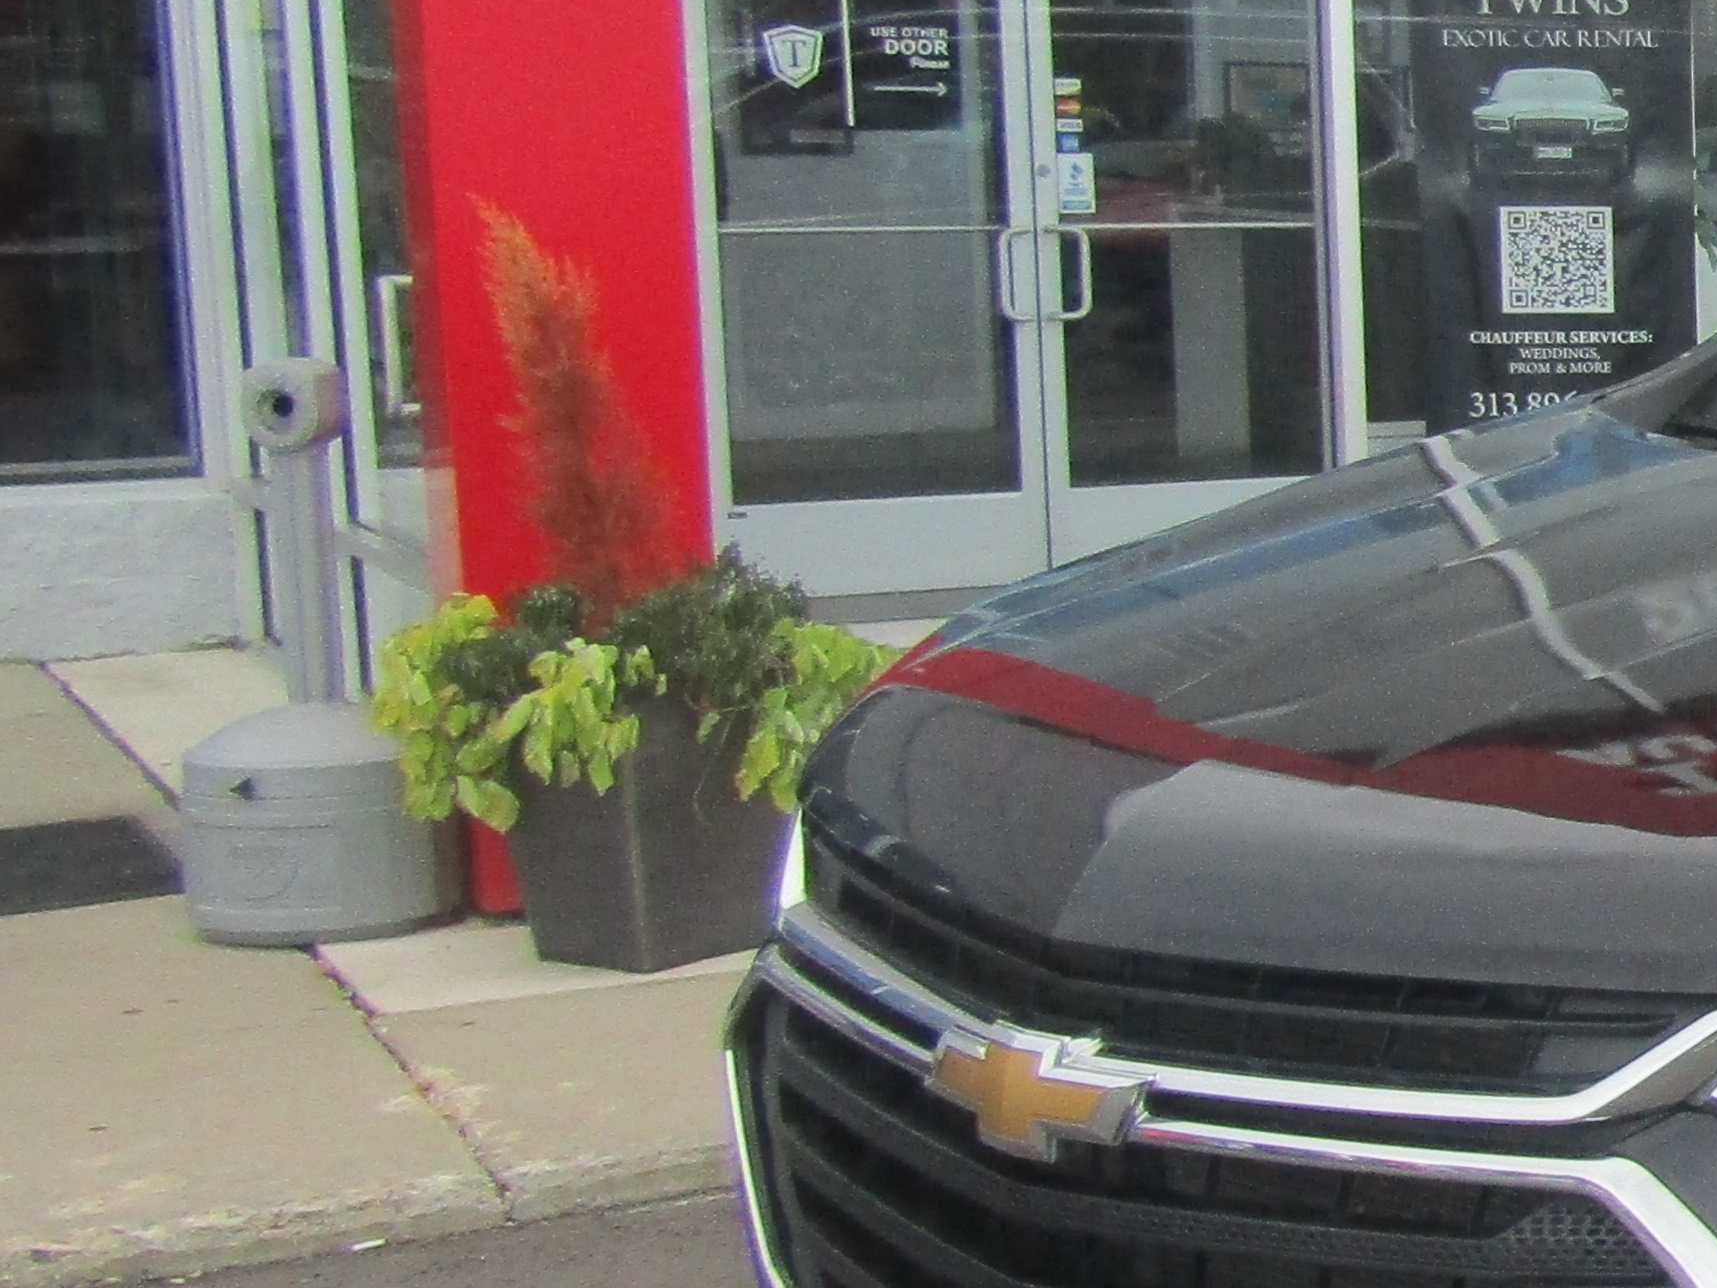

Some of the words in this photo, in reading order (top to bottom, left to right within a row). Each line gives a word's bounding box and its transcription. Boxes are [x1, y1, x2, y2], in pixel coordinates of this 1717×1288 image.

[870, 26, 897, 37] USE
[902, 27, 949, 38] OTHER
[1442, 29, 1517, 47] EXOTIC
[1524, 29, 1571, 47] CAR
[1578, 29, 1658, 48] RENTAL
[782, 40, 807, 67] T
[885, 39, 949, 55] DOOR
[1470, 331, 1568, 344] CHAUFFEUR
[1569, 330, 1654, 344] SERVICES:
[1519, 348, 1601, 360] WEDDINGS,
[1510, 362, 1550, 374] PROM
[1556, 362, 1567, 374] &
[1569, 362, 1612, 373] MORE
[1469, 392, 1518, 417] 313
